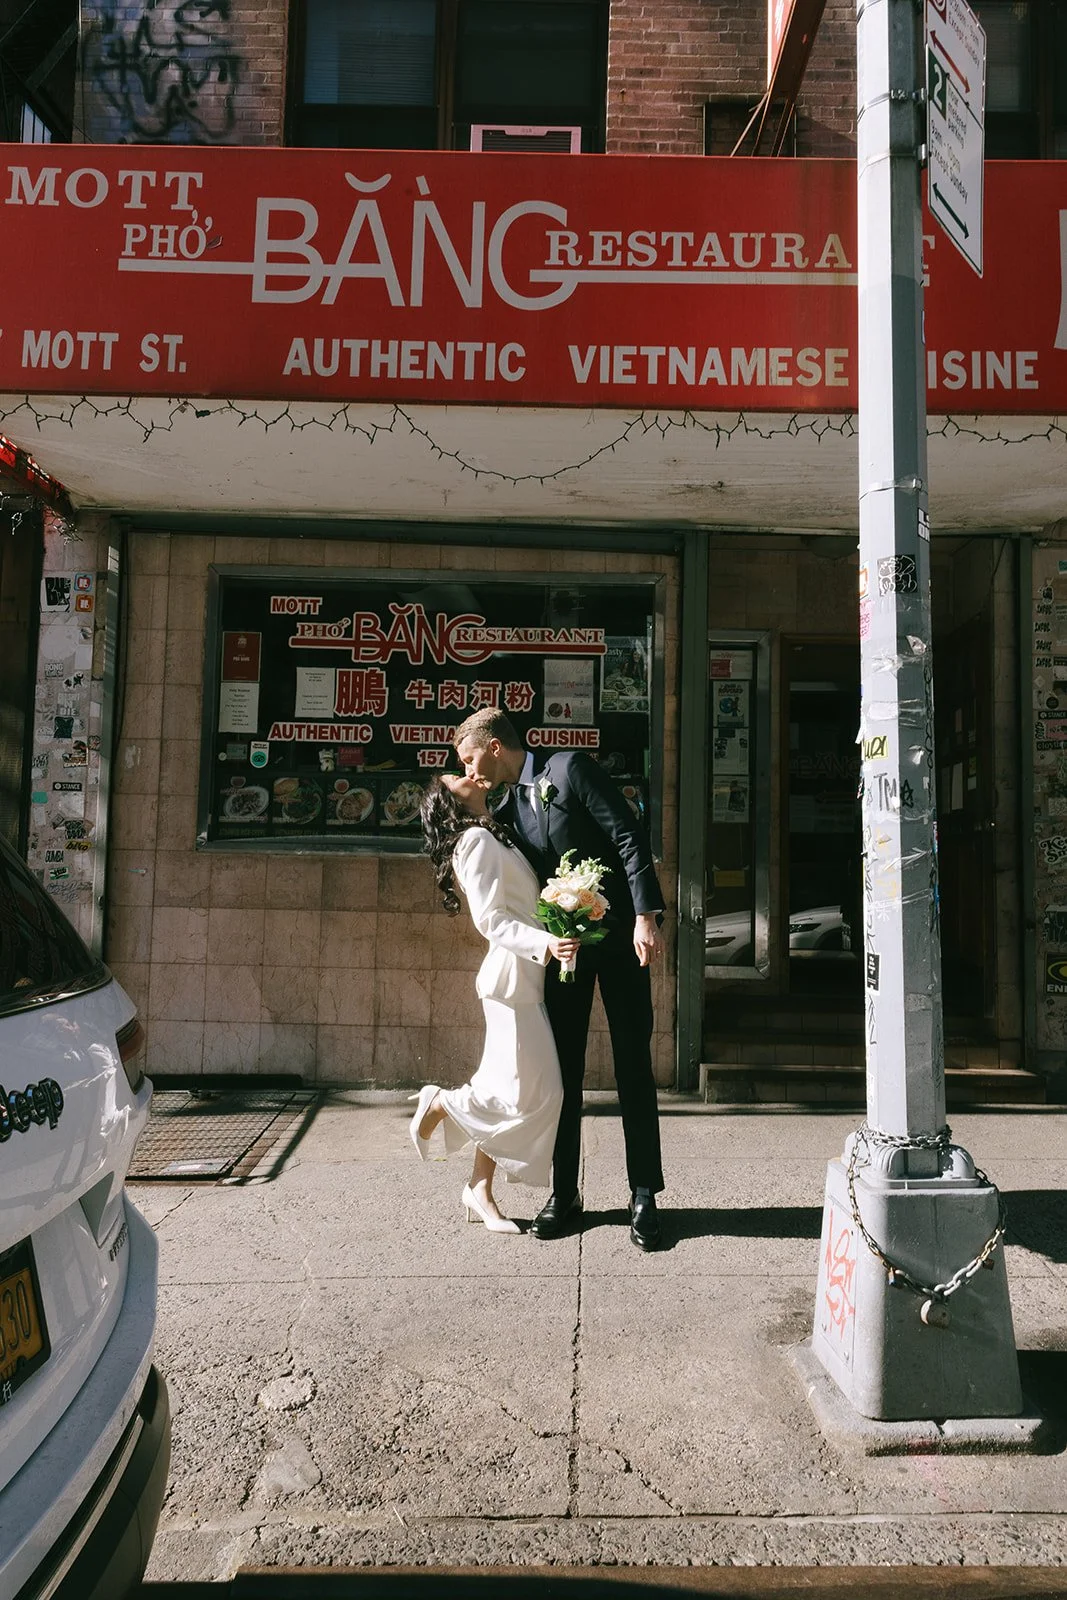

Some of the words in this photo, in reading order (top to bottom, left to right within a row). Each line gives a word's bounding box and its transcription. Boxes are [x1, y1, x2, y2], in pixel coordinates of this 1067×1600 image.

[933, 63, 943, 111] 2
[948, 102, 966, 135] metered
[948, 118, 964, 149] parking
[5, 166, 203, 211] MOTT
[949, 166, 968, 204] Sunday
[21, 330, 119, 371] MOTT
[140, 334, 187, 374] ST.
[283, 337, 526, 382] AUTHENTIC
[568, 345, 849, 387] VIETNAMESE
[270, 596, 322, 615] MOTT
[454, 627, 605, 643] RESTAURANT
[334, 668, 388, 717] 鵬
[405, 679, 535, 712] 牛肉河粉
[268, 723, 372, 742] AUTHENTIC
[526, 728, 600, 748] CUISINE
[417, 749, 449, 768] 157
